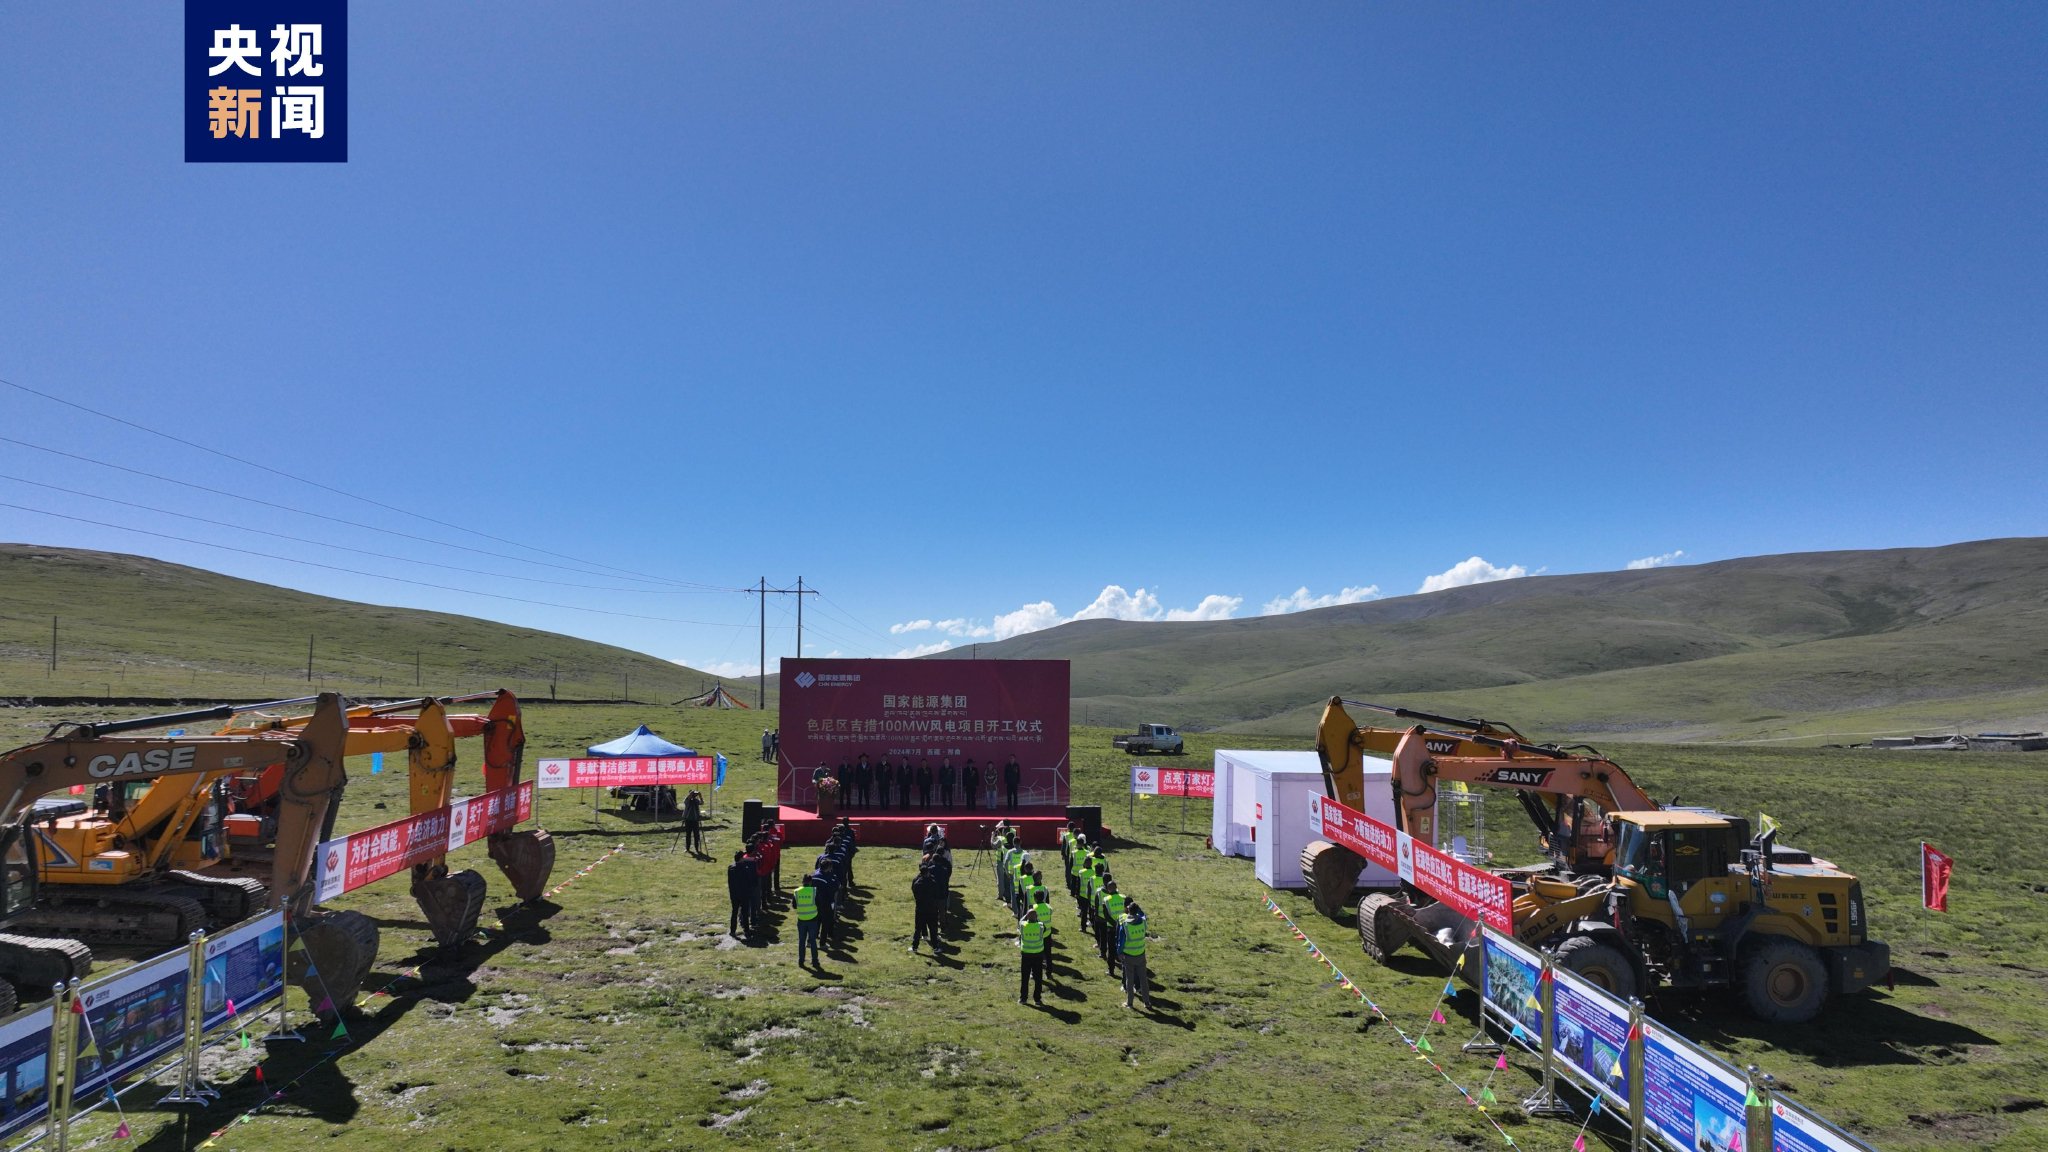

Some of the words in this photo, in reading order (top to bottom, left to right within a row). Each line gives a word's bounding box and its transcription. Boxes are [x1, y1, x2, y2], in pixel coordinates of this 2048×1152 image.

[883, 694, 967, 708] 国家能源集团
[807, 719, 1043, 733] 色尼区吉措100MW风电项目开工仪式
[1425, 741, 1453, 752] ANY
[88, 746, 197, 779] CASE
[1497, 771, 1542, 783] SANY
